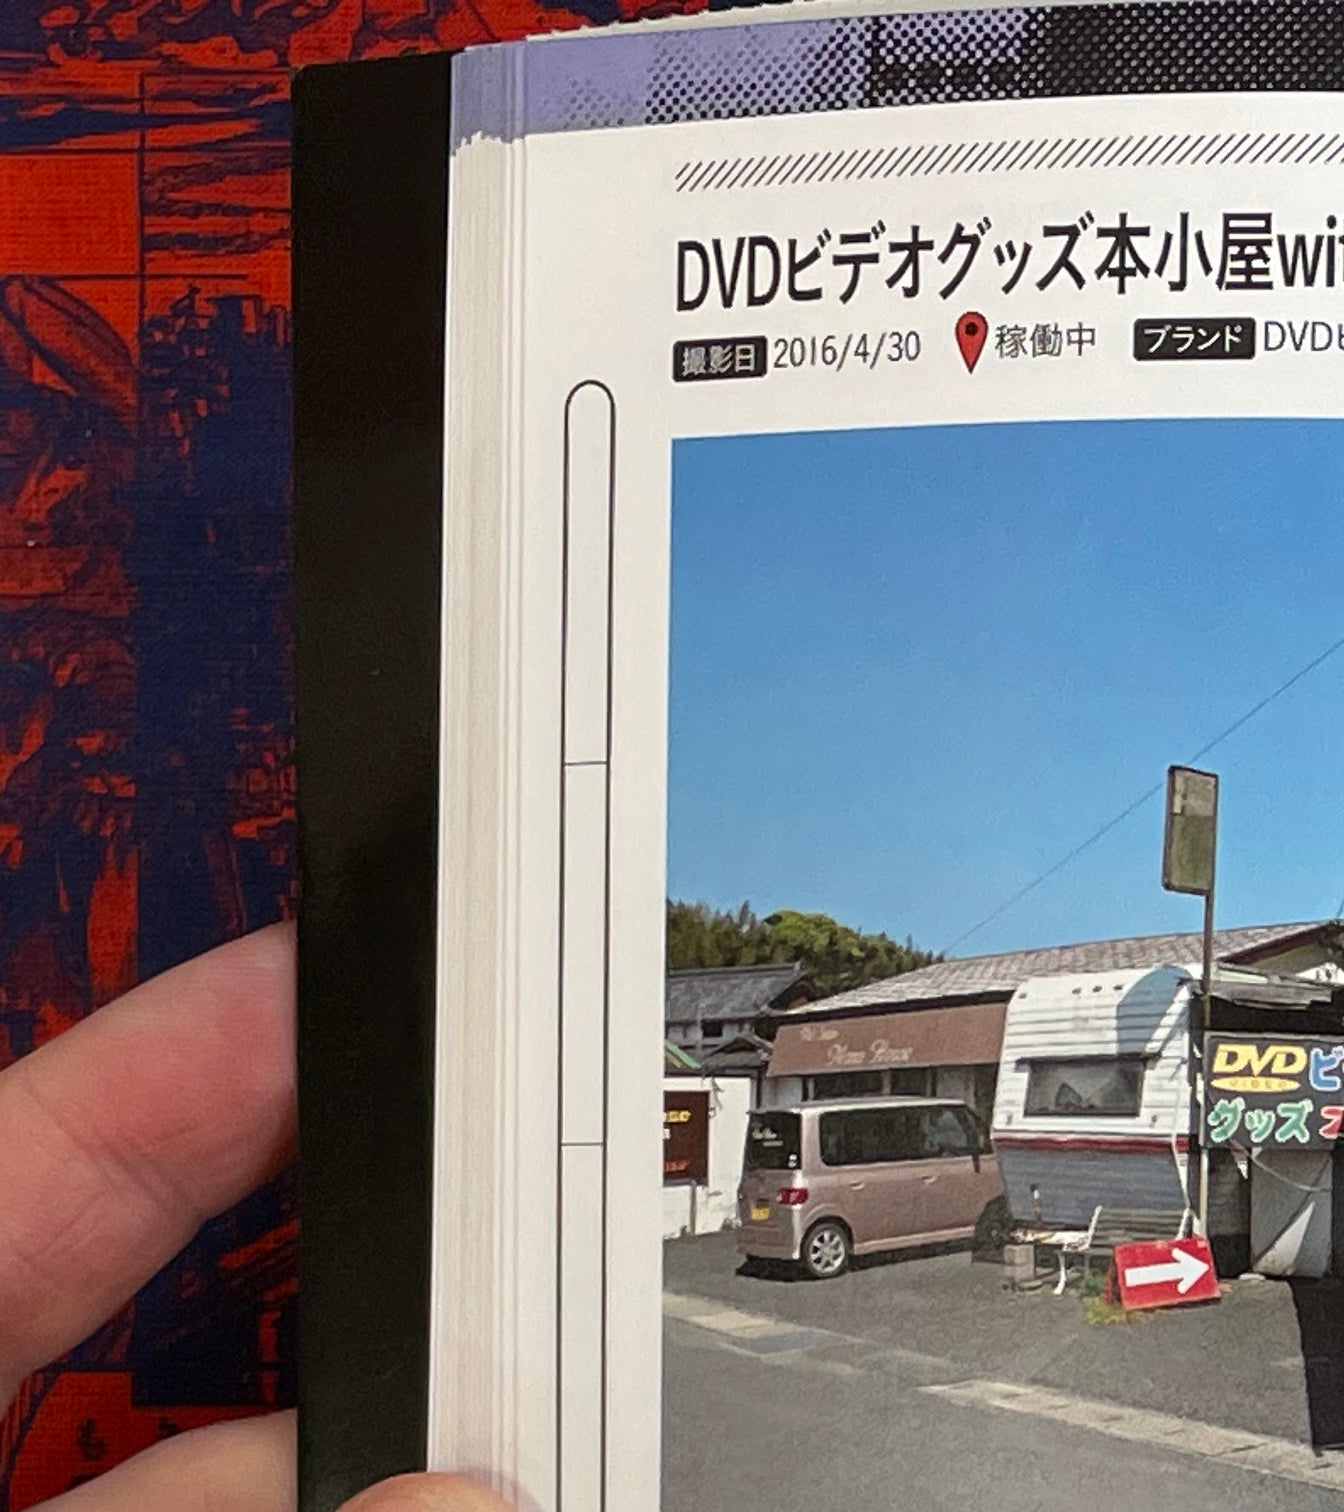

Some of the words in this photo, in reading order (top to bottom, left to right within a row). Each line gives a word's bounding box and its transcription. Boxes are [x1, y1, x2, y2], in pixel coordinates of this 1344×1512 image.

[681, 343, 757, 376] 撮影日
[773, 331, 922, 371] 2016/4/30
[995, 322, 1097, 360] 稼働中
[1141, 324, 1244, 355] ブランド
